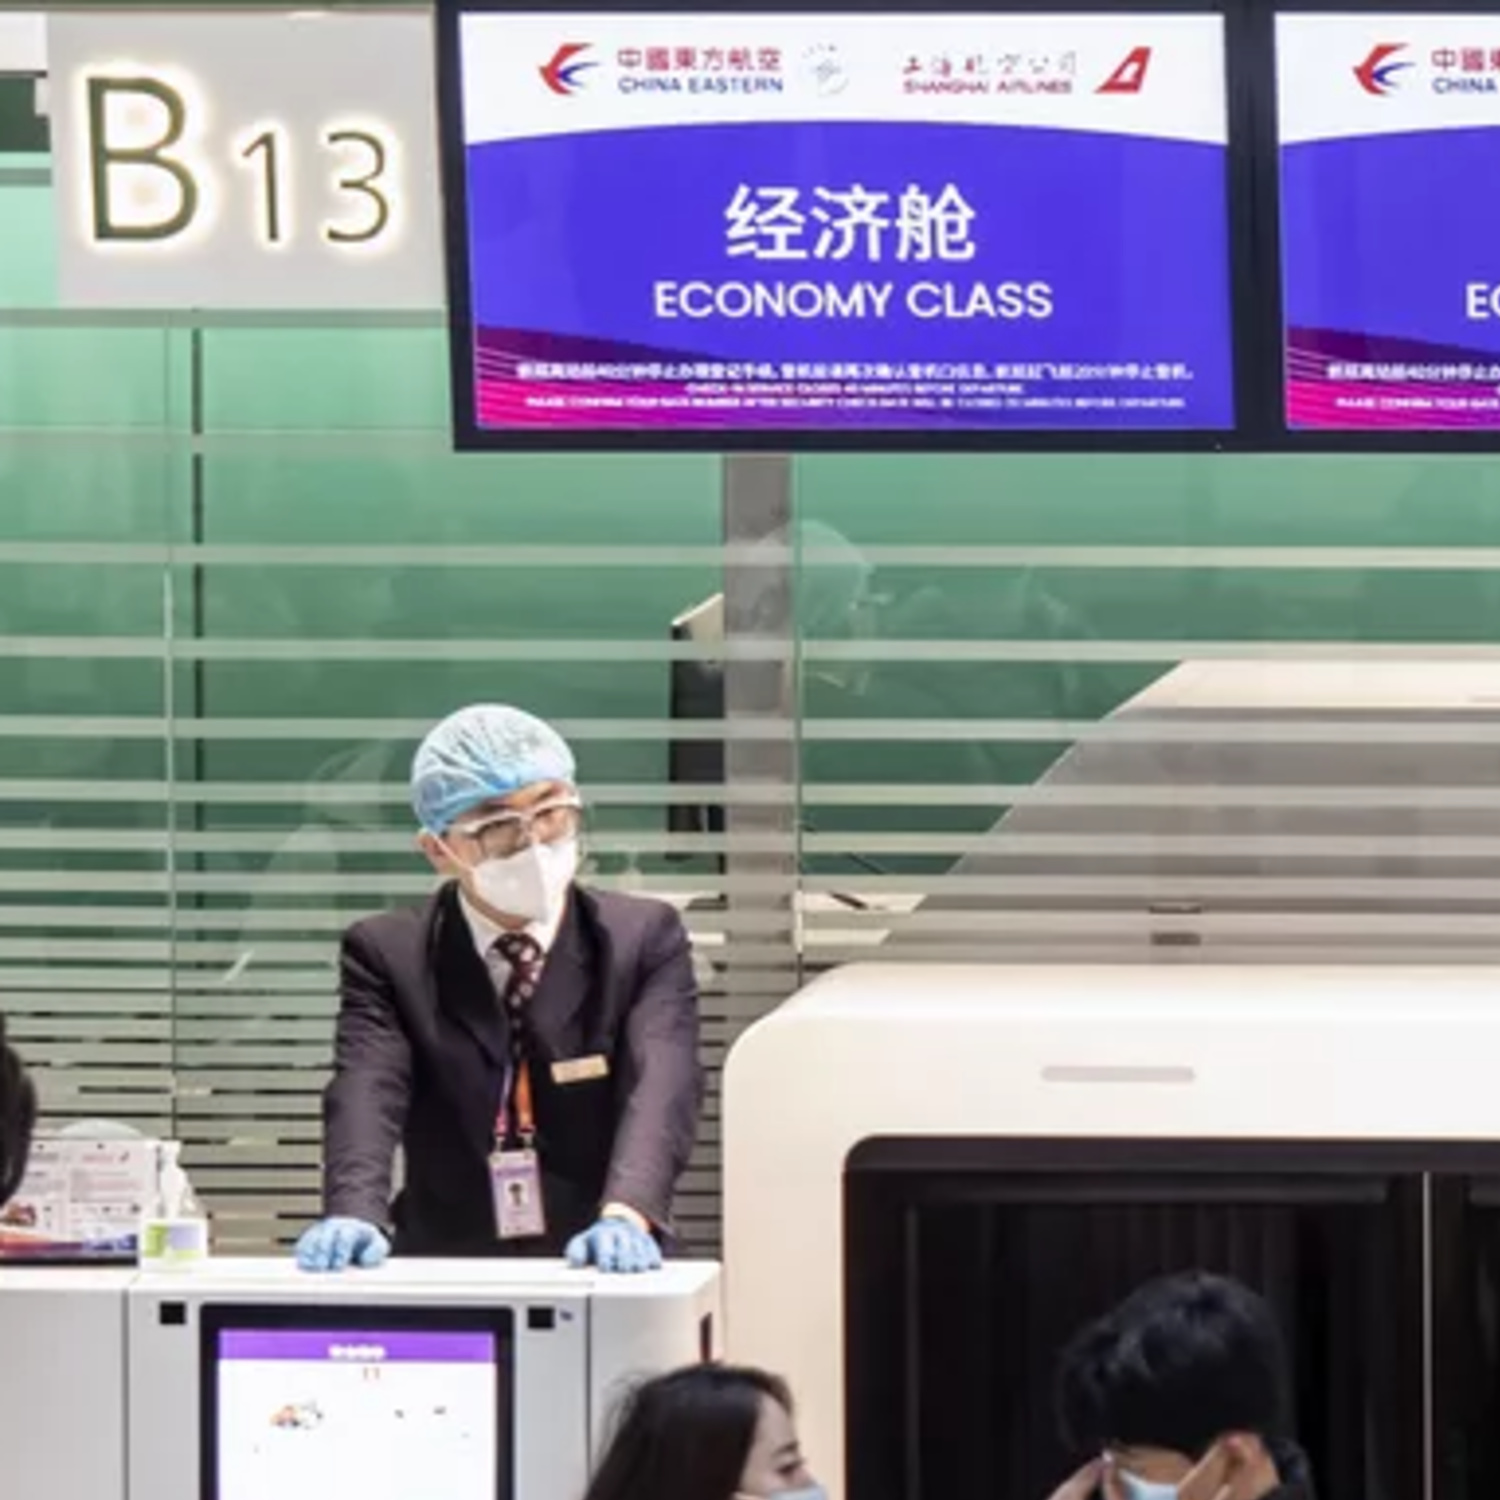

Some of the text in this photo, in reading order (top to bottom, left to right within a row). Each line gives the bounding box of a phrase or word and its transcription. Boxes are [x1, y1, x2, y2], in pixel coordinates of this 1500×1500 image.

[617, 47, 783, 73] 中國東方航空
[618, 77, 783, 95] CHINA EASTERN
[903, 80, 1074, 95] SHANGHAI AIRLINES
[1432, 78, 1497, 95] CHINA
[724, 183, 976, 261] 经济舱
[654, 281, 1054, 319] ECONOMY CLASS
